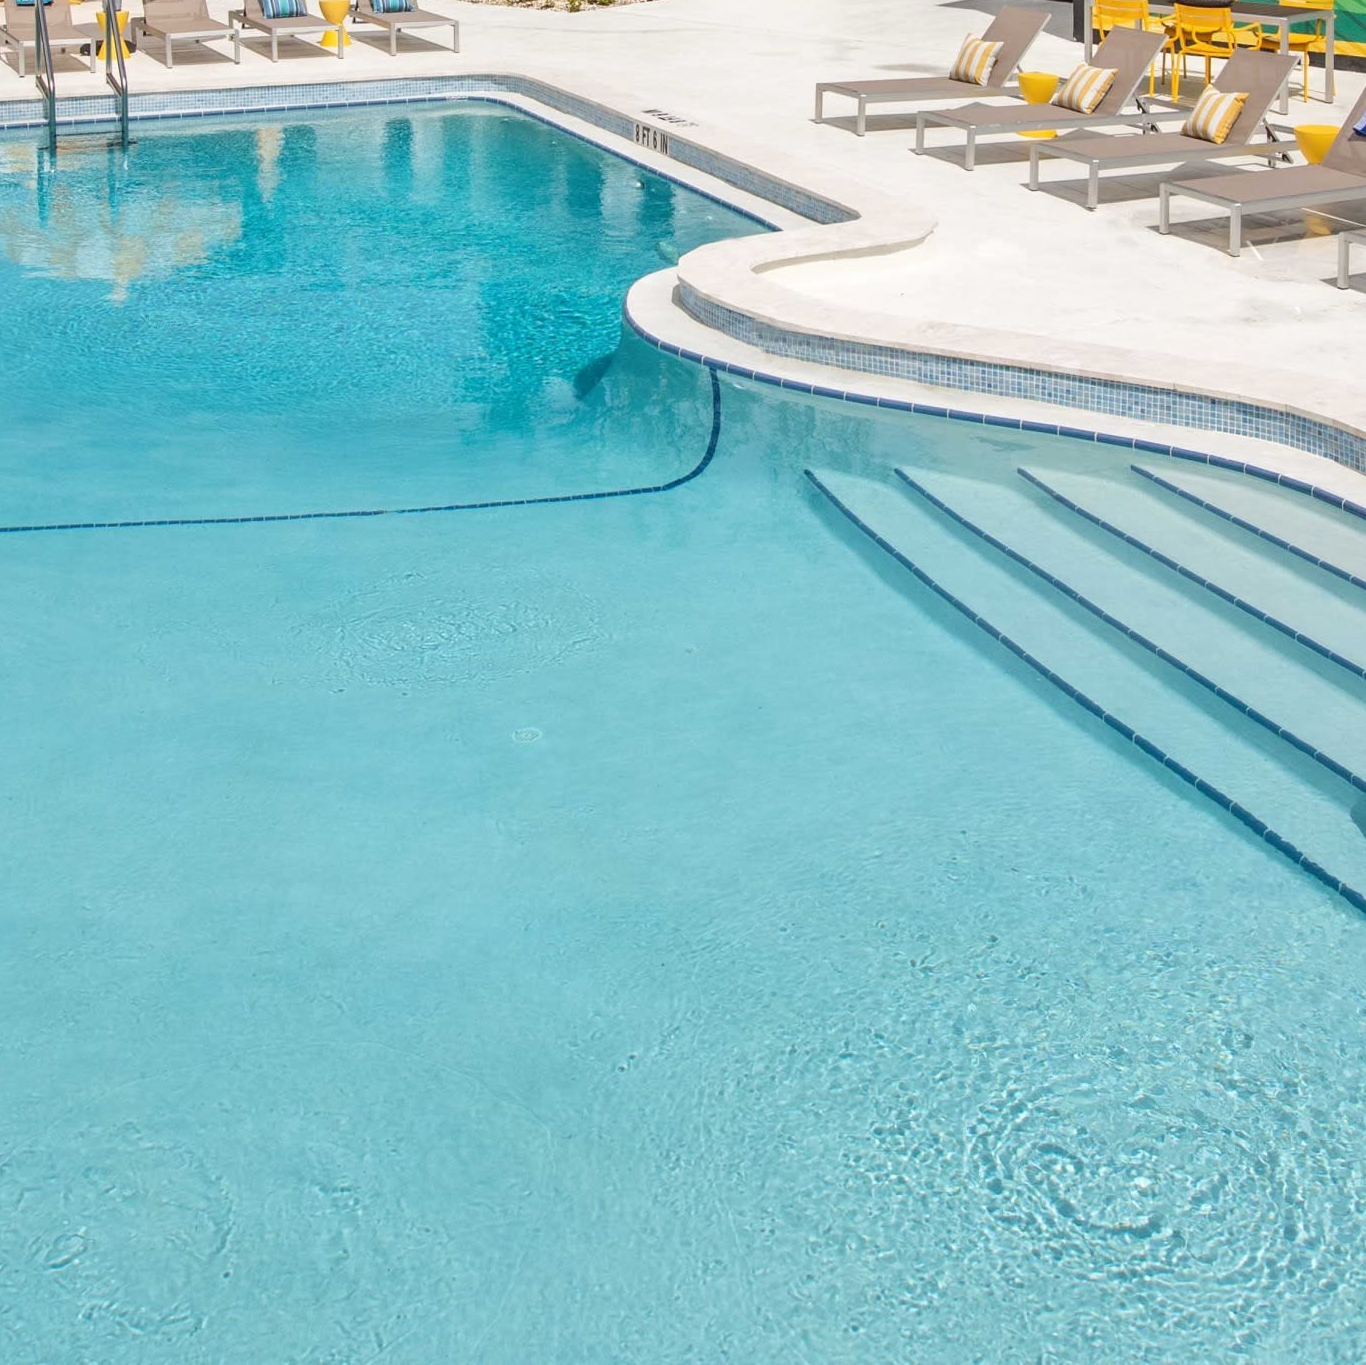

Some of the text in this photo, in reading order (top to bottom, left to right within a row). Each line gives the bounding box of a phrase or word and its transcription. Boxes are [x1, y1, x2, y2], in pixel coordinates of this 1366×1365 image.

[635, 123, 668, 155] 8 FT 6 IN
